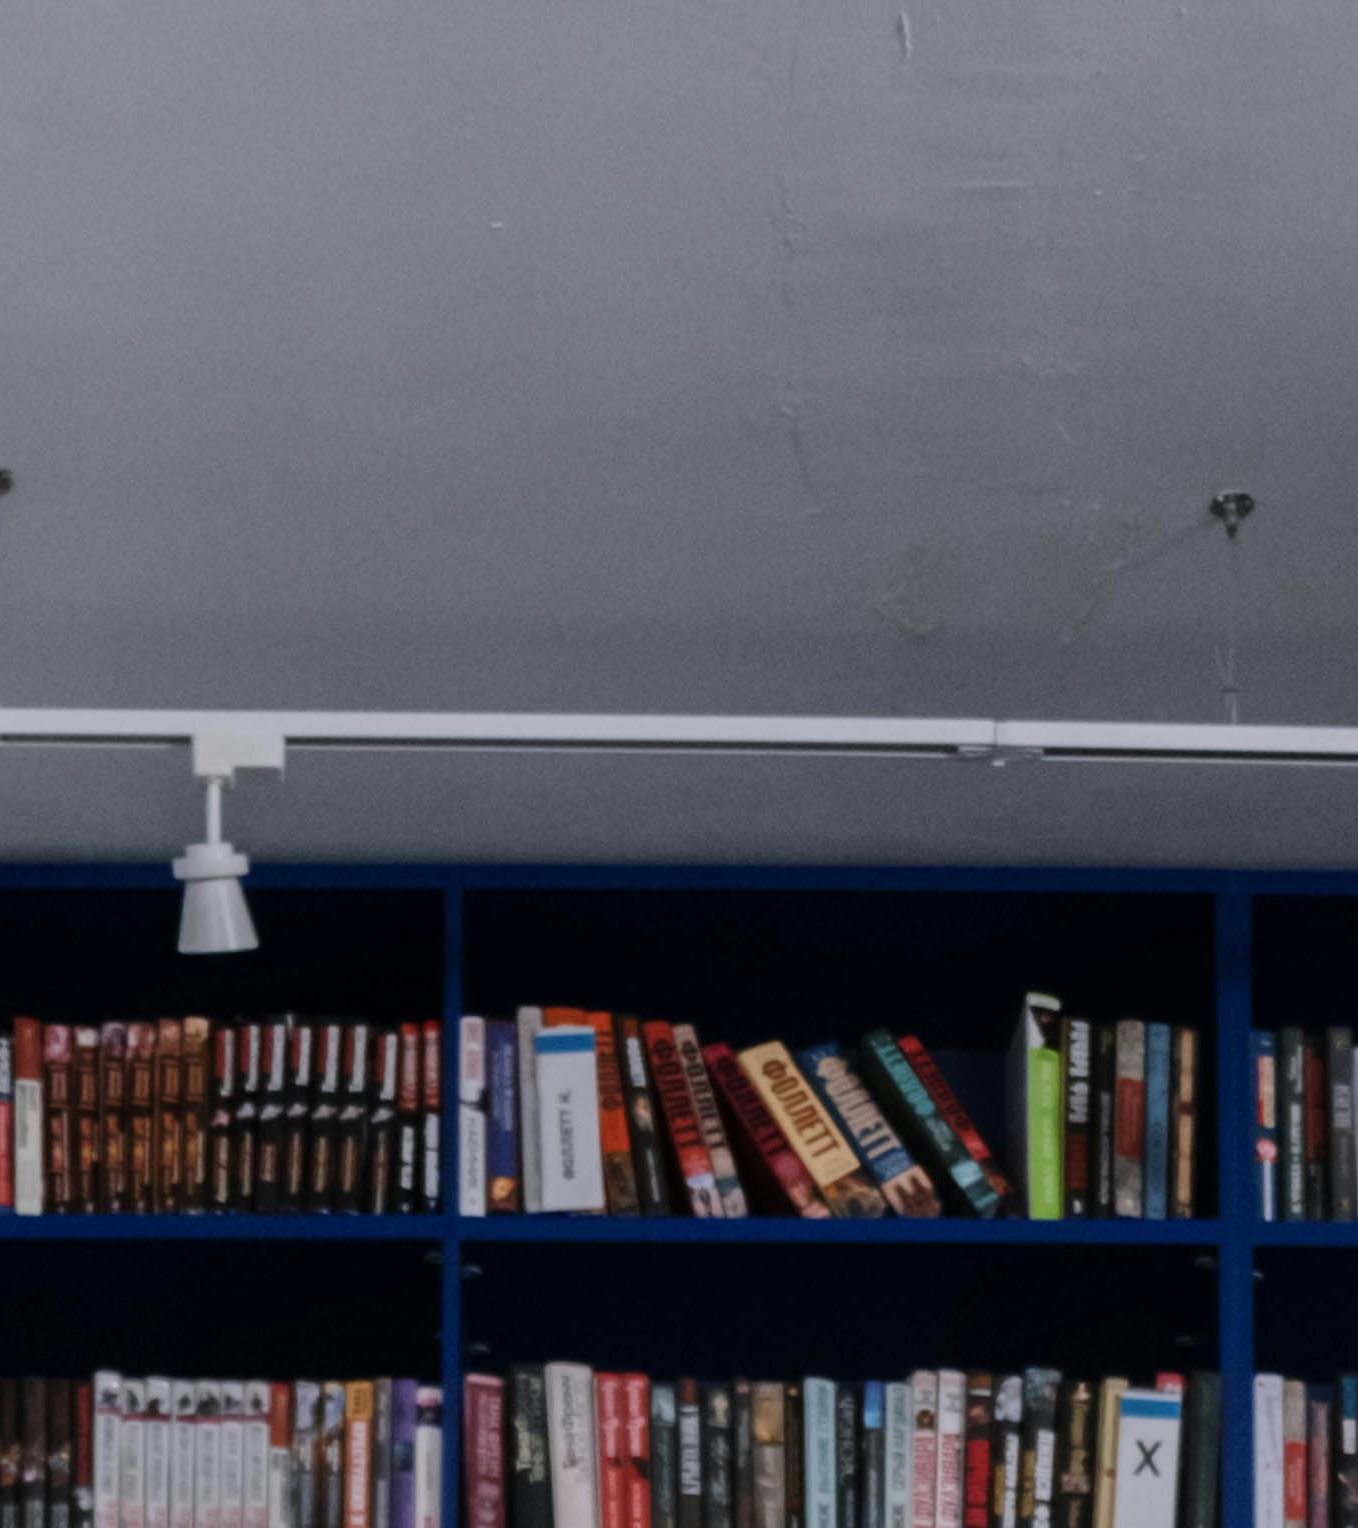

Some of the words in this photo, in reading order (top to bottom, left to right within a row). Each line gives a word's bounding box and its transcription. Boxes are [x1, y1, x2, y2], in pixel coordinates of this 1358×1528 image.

[558, 1107, 575, 1182] ФОЛЛЕТТ
[762, 1058, 840, 1161] ФОЛЛЕТТ
[1132, 1439, 1163, 1478] Х
